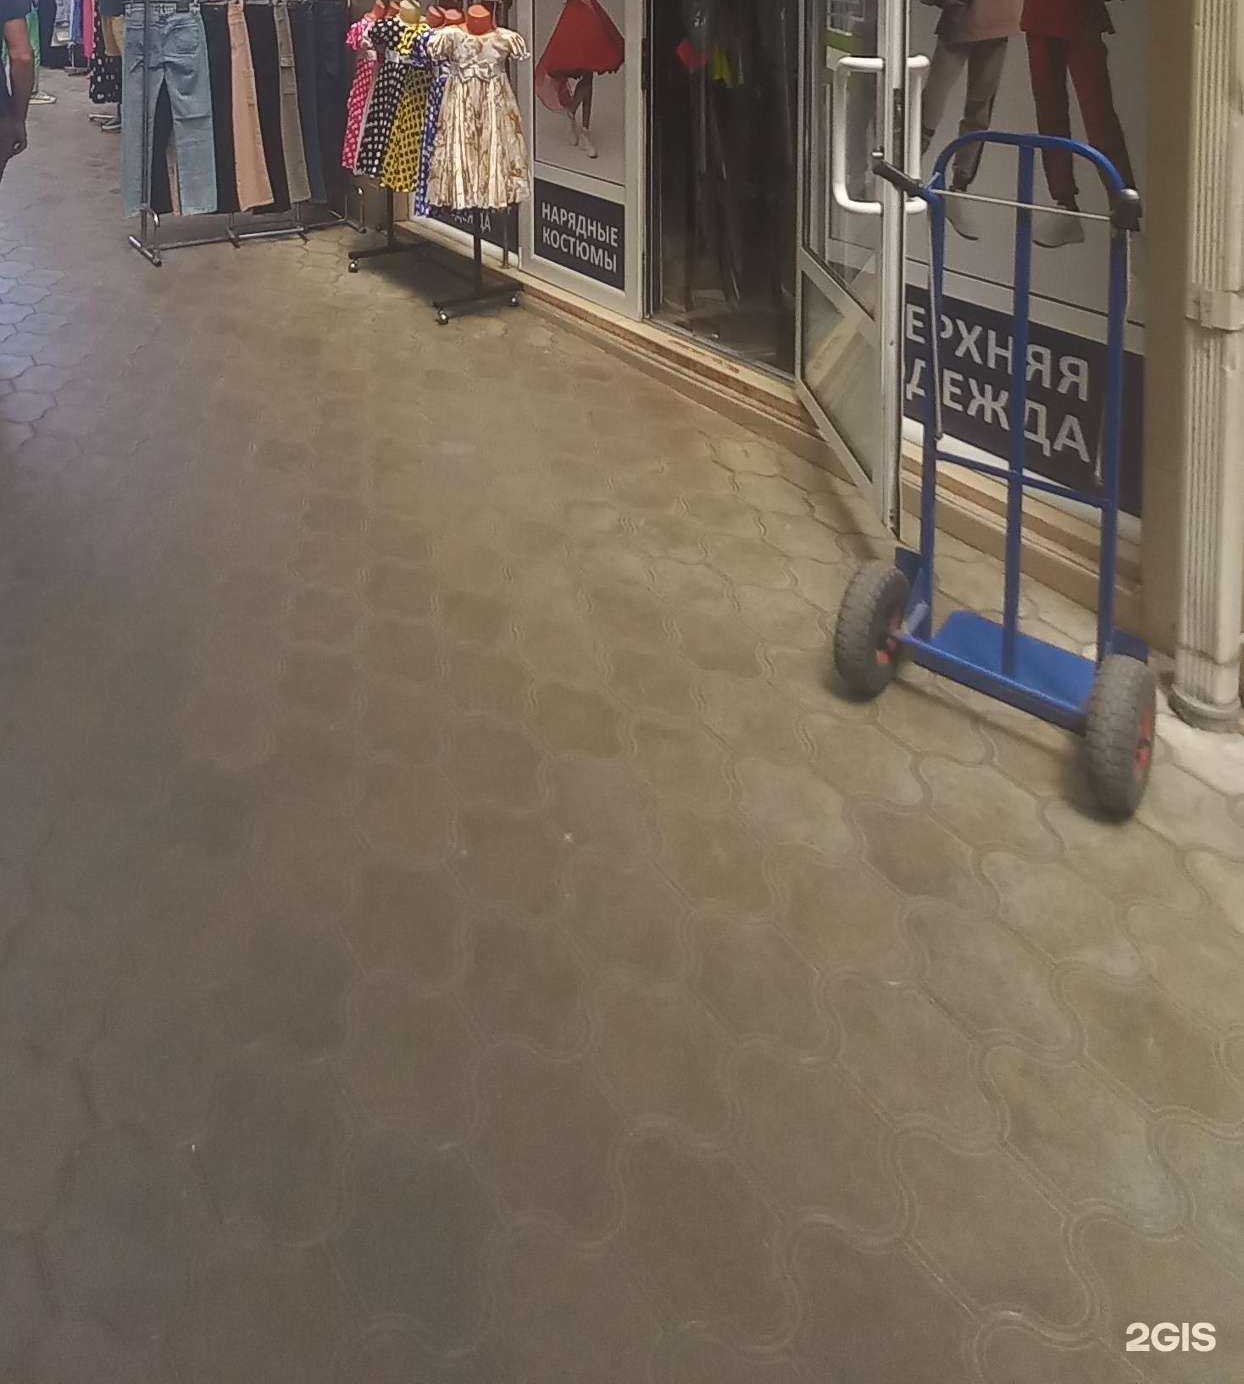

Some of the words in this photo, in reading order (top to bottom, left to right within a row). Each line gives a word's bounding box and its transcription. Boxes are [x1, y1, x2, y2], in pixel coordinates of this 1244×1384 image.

[541, 201, 619, 248] НАРЯДНЫЕ
[542, 226, 617, 274] КОСТЮМЫ
[905, 303, 1089, 402] ЕРХНЯЯ
[905, 358, 1091, 464] ДЕЖДА
